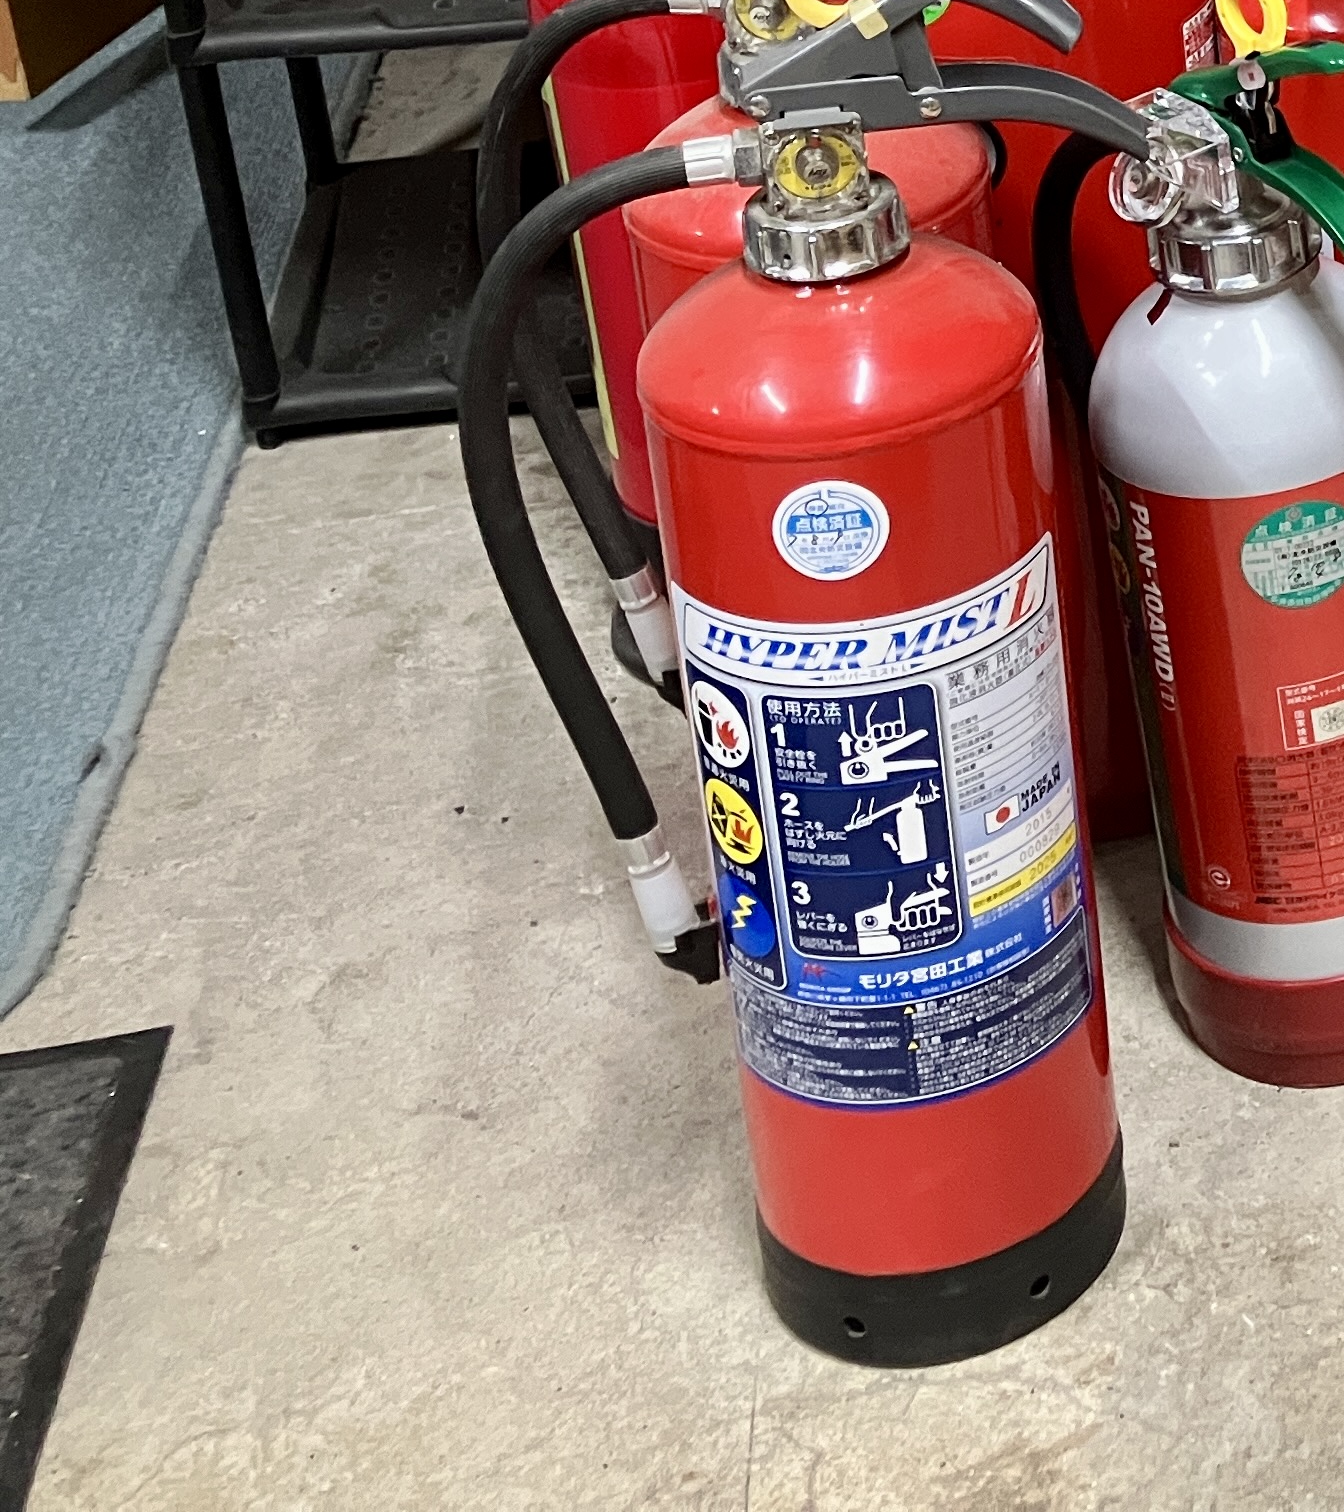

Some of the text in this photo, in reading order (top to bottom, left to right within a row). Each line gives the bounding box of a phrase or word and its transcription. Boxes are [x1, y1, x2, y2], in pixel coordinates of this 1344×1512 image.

[697, 568, 1037, 672] HYPER MIST L
[766, 698, 842, 719] 使用方法
[769, 723, 787, 748] 1
[779, 792, 801, 817] 2
[1021, 770, 1061, 813] JAPAN
[1024, 808, 1053, 838] 2015
[1029, 849, 1057, 881] 2025
[791, 880, 812, 906] 3
[795, 910, 836, 923] レバーを
[858, 948, 985, 991] モリタ宮田工業
